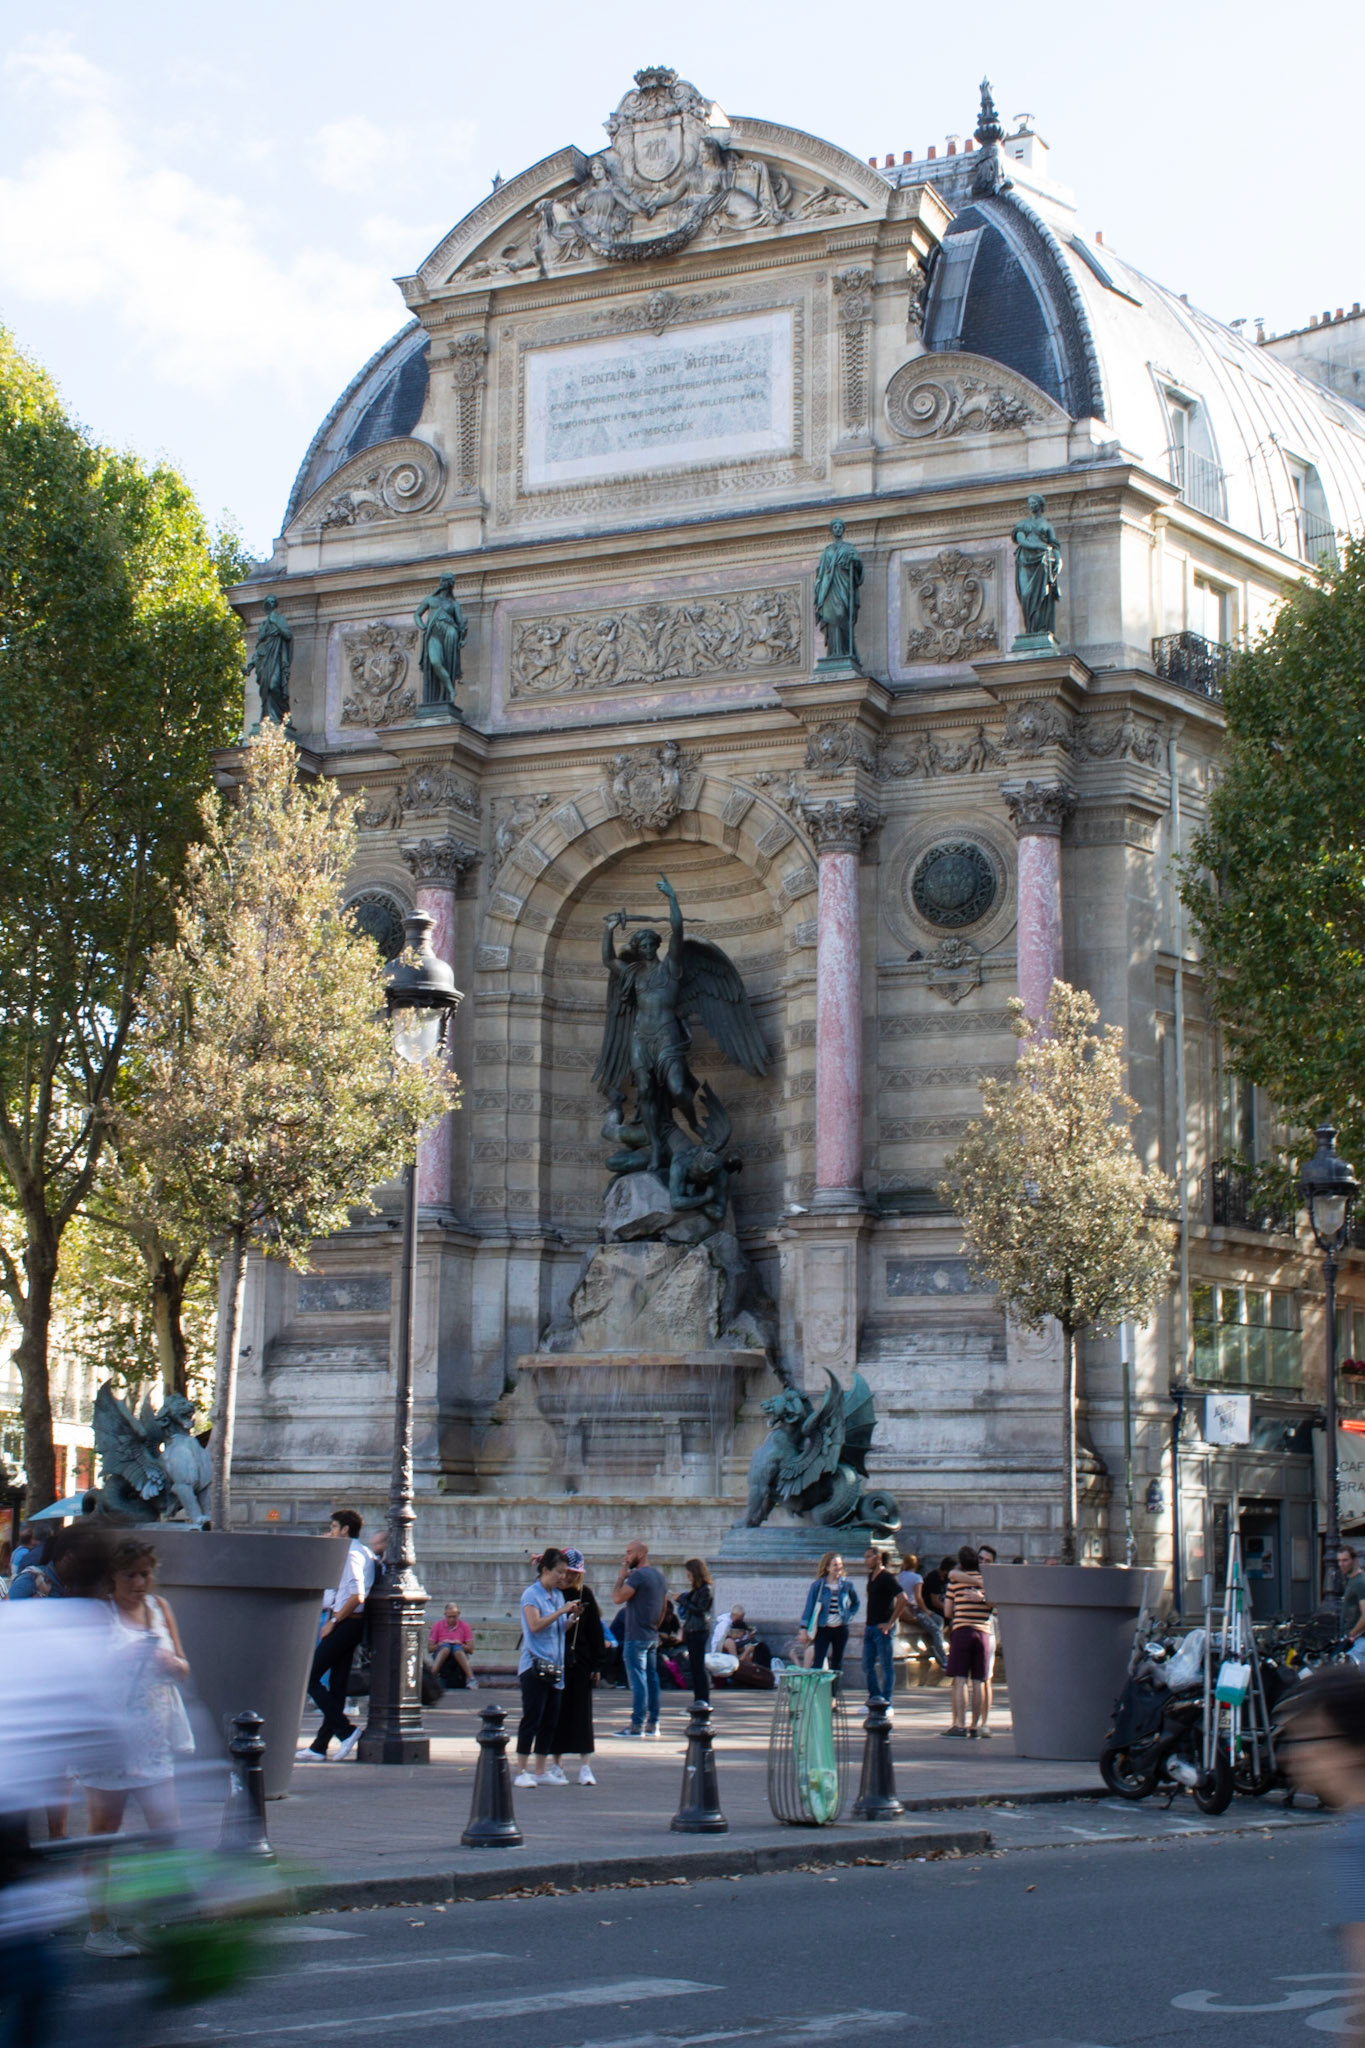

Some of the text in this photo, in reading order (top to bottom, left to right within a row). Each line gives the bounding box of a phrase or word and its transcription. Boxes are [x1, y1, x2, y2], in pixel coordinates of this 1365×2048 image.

[581, 354, 732, 386] FONTAINE SAINT MICHEL
[564, 414, 610, 429] MONUMENT
[684, 401, 695, 410] LA
[698, 396, 722, 408] VILLE
[724, 394, 735, 403] DE
[740, 390, 764, 401] PARIS
